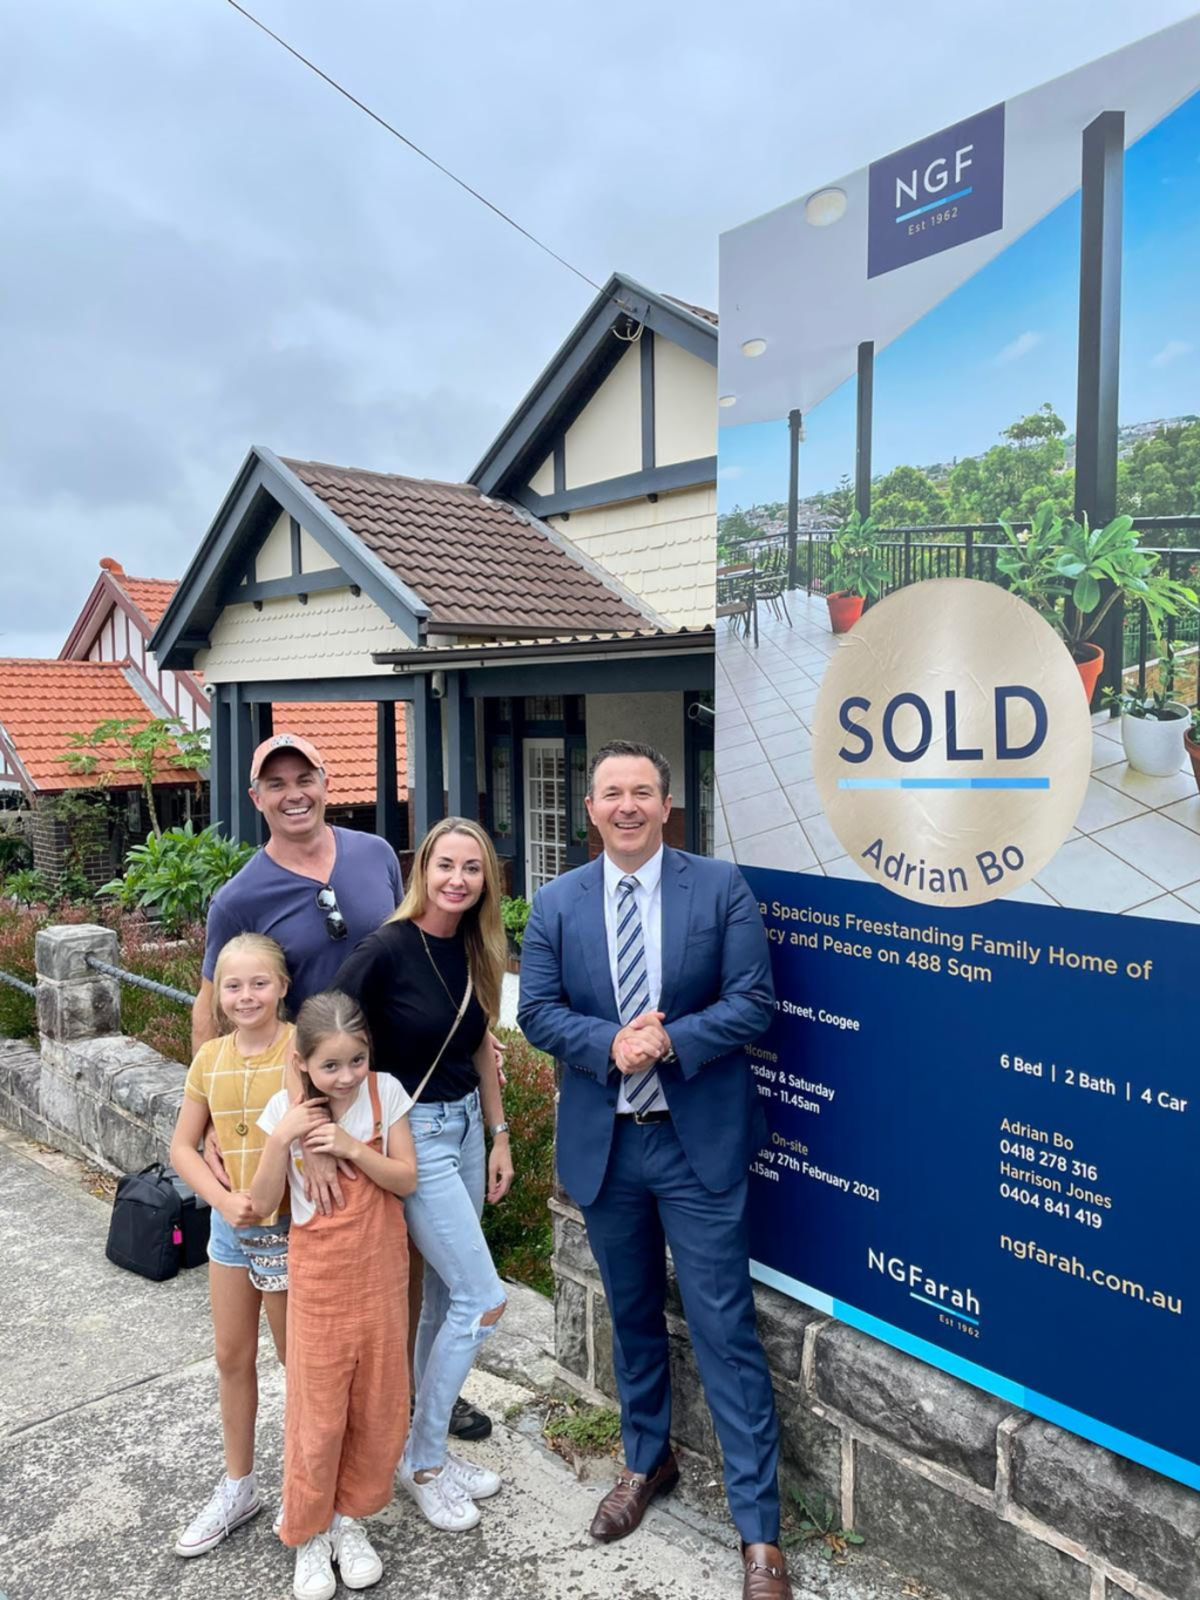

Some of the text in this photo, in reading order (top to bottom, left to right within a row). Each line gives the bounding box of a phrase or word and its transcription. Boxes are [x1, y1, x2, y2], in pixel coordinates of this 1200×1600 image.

[896, 144, 973, 208] NGF
[908, 206, 958, 236] Est 1962
[838, 685, 1048, 763] SOLD
[861, 838, 1025, 893] Adrian Bo
[771, 901, 840, 927] Spacious
[845, 913, 964, 951] Freestanding
[971, 934, 1041, 964] Family
[1049, 946, 1118, 975] Home
[1126, 960, 1153, 980] of
[790, 932, 818, 949] and
[823, 935, 873, 960] Peace
[878, 948, 900, 965] on
[906, 951, 942, 973] 488
[948, 958, 992, 983] Sqm
[782, 1000, 816, 1021] Street,
[818, 1009, 860, 1031] Coogee
[779, 1071, 786, 1085] &
[788, 1074, 835, 1101] Saturday
[780, 1089, 820, 1114] 11.45am
[1000, 1054, 1010, 1068] 6
[1014, 1056, 1043, 1077] Bed
[1065, 1069, 1075, 1085] 2
[1079, 1072, 1116, 1095] Bath
[1141, 1088, 1152, 1104] 4
[1157, 1092, 1188, 1112] Car
[771, 1132, 809, 1155] On-site
[1000, 1117, 1074, 1151] Adrian Bo
[777, 1152, 800, 1172] 27th
[802, 1162, 850, 1192] February
[852, 1181, 880, 1202] 2021
[1000, 1139, 1098, 1181] 0418 278 316
[1000, 1161, 1112, 1209] Harrison Jones
[1000, 1183, 1102, 1229] 0404 841 419
[868, 1247, 980, 1315] NGFarah
[1000, 1234, 1183, 1314] ngfarah.com.au
[939, 1314, 980, 1338] Est 1962
